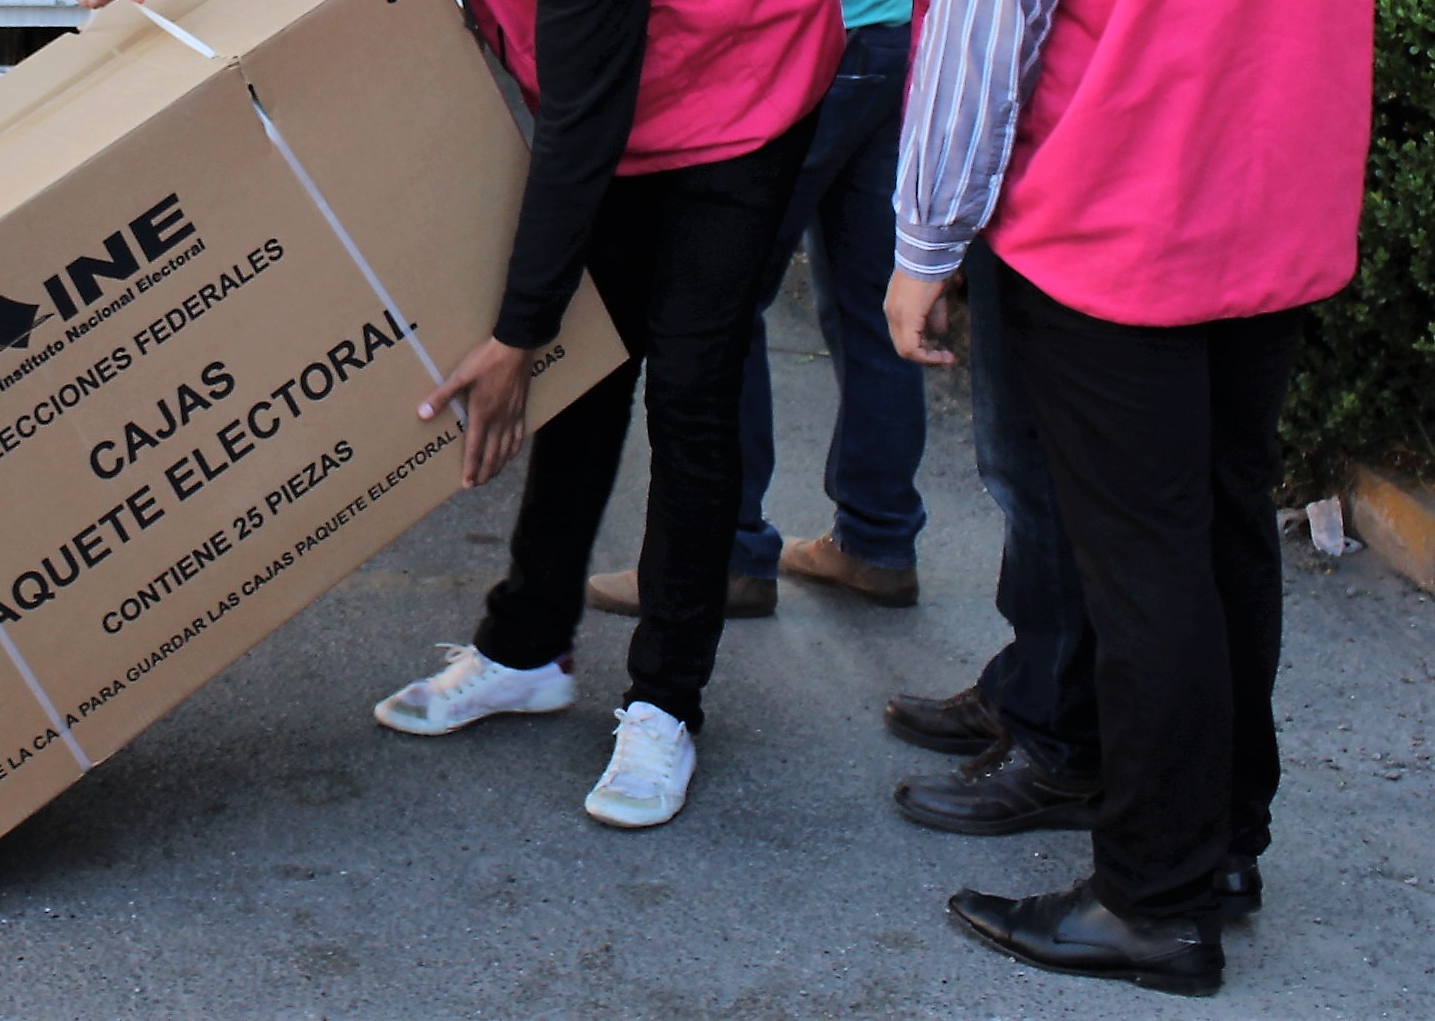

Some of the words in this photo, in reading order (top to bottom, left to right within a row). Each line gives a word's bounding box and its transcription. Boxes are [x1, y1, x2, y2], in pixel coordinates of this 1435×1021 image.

[43, 192, 197, 322] INE
[65, 287, 136, 344] Nacional
[136, 237, 207, 294] Electoral
[132, 237, 285, 356] FEDERALES
[88, 360, 236, 480] CAJAS
[164, 308, 419, 501] ELECTORAL
[7, 747, 34, 770] LA
[33, 712, 81, 752] CAA
[78, 679, 127, 718] PARA
[125, 616, 209, 683] GUARDAR
[206, 592, 241, 624] LAS
[241, 551, 295, 597] CAJAS
[295, 494, 369, 557] PAQUETE
[367, 430, 458, 502] ELECTORAL
[101, 529, 234, 635] CONTIENE
[232, 506, 265, 541] 25
[264, 439, 355, 516] PIEZAS
